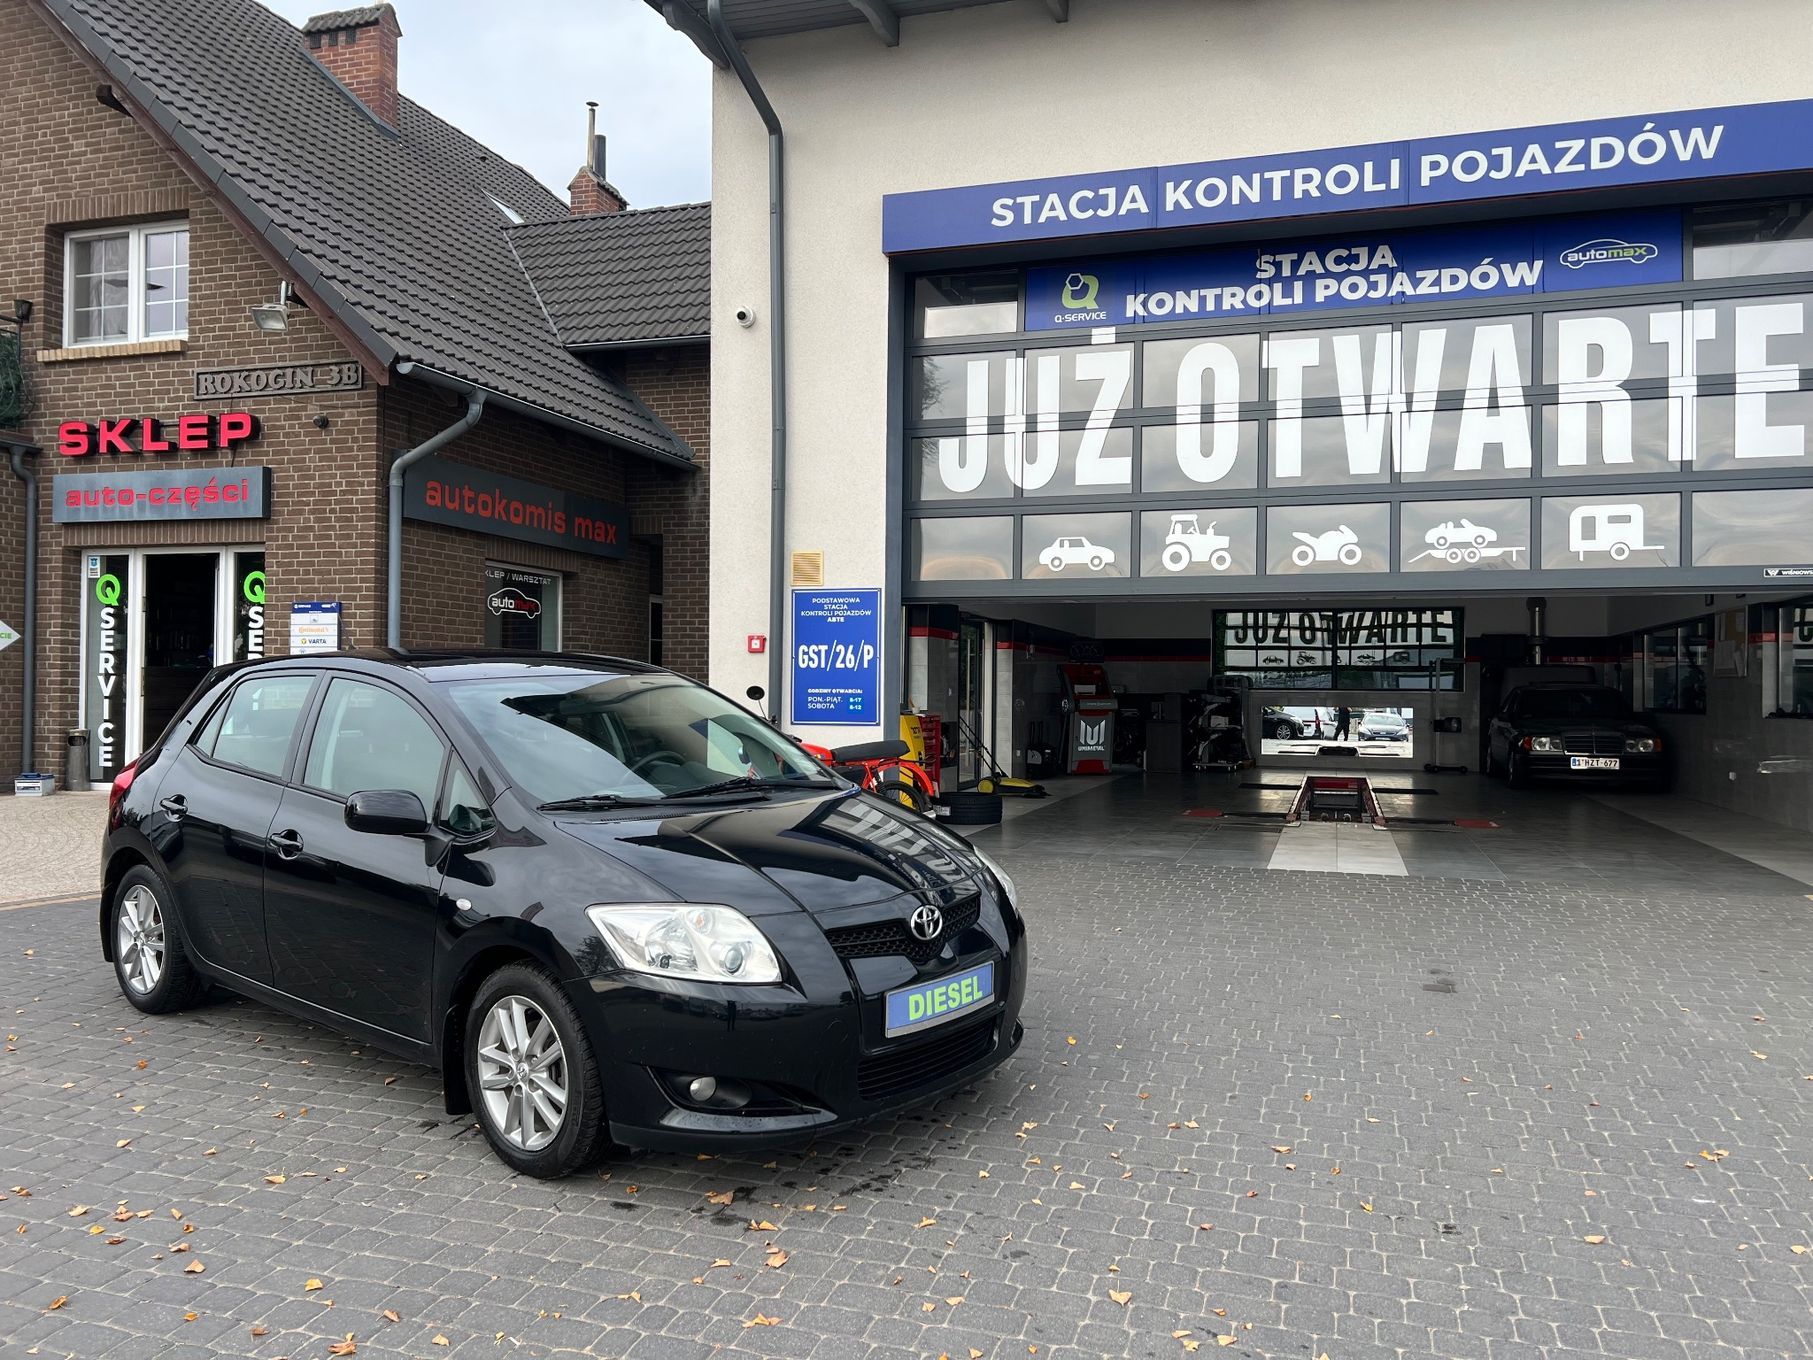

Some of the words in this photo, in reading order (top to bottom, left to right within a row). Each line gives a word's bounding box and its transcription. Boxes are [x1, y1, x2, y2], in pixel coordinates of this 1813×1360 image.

[991, 184, 1150, 227] STACJA
[1165, 157, 1400, 212] KONTROLI
[1420, 122, 1725, 188] POJAZDÓW
[1255, 244, 1398, 279] STACJA
[1567, 247, 1647, 262] automax
[1125, 279, 1303, 318] KONTROLI
[1317, 257, 1544, 302] POJAZDÓW
[326, 364, 359, 386] 3B
[938, 326, 1133, 493] JUŻ
[1176, 302, 1805, 484] OTWARTE
[57, 412, 255, 457] SKLEP
[65, 476, 250, 512] auto-części
[425, 480, 567, 534] autokomis
[575, 516, 617, 546] max
[95, 573, 121, 606] Q
[243, 570, 266, 605] Q
[511, 573, 552, 585] WARSZTAT
[798, 639, 875, 672] GST/26/P
[97, 607, 116, 767] SERVICE
[908, 975, 983, 1021] DIESEL
